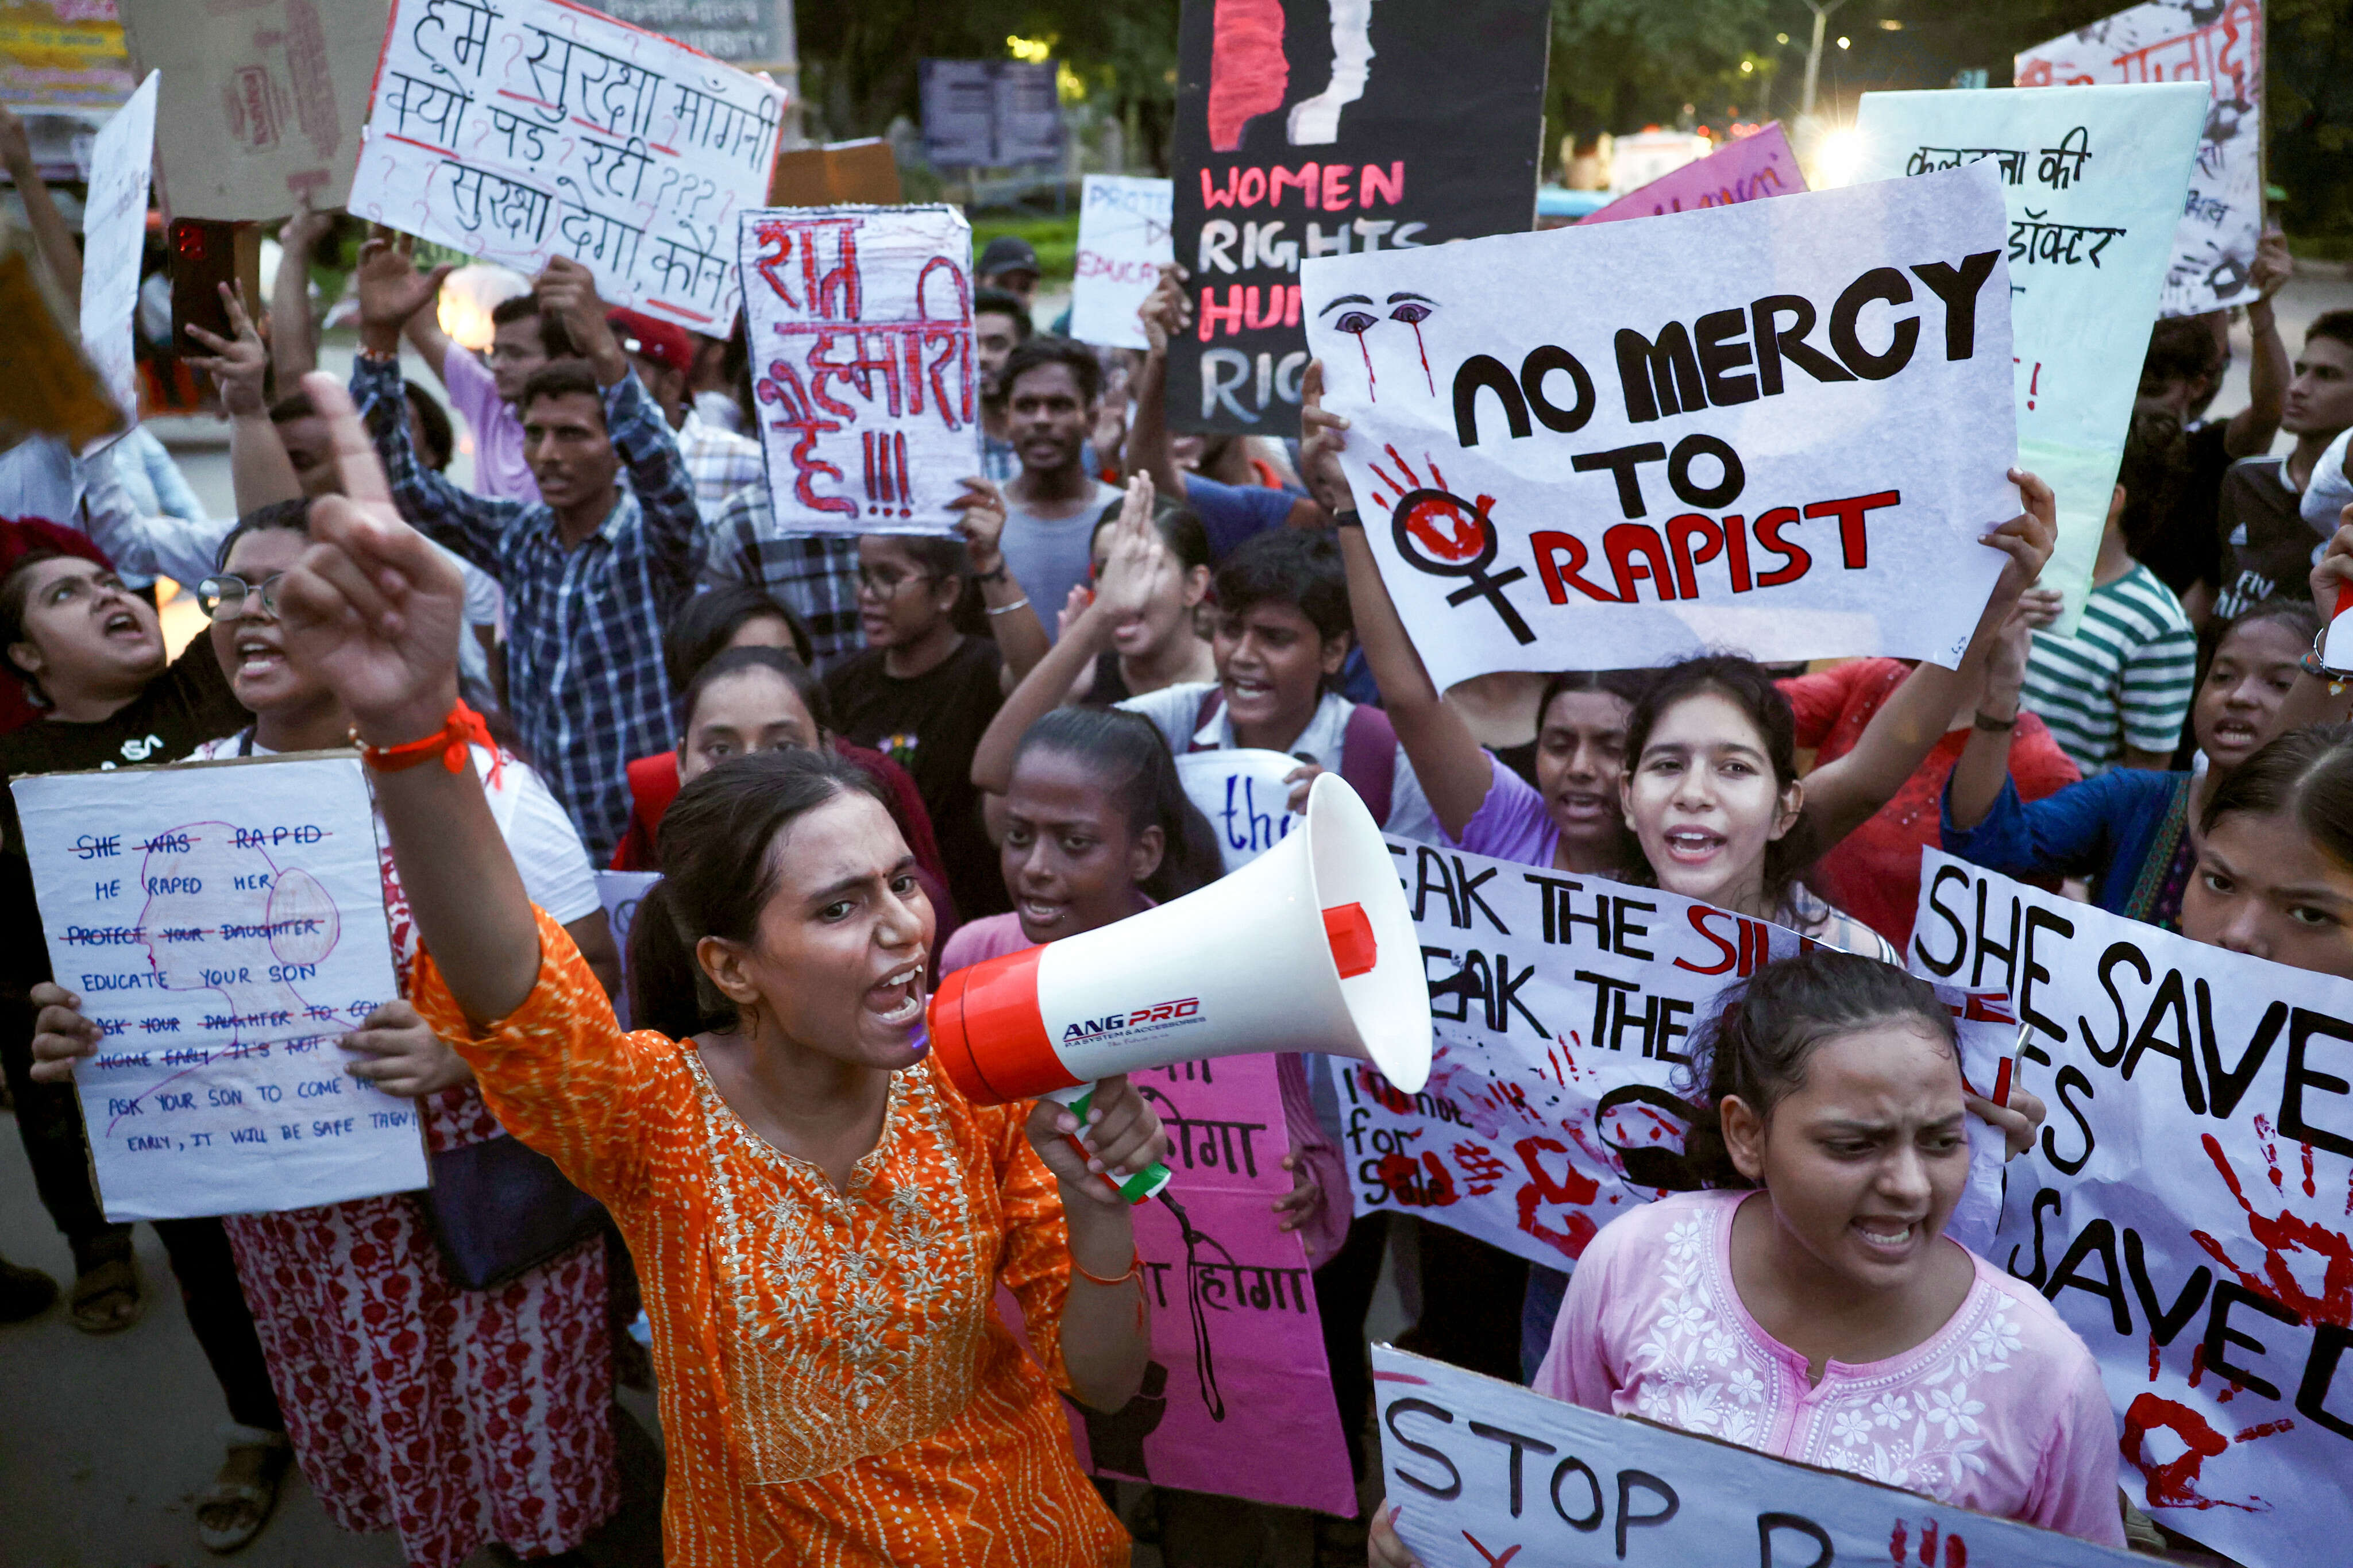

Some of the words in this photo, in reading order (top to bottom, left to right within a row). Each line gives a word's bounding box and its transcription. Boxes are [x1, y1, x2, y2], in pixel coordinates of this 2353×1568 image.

[2038, 126, 2092, 190] की
[1200, 161, 1405, 211] WOMEN
[754, 217, 864, 322] रात
[1197, 217, 1429, 275] RIGHTS
[1452, 345, 1596, 447] NO
[1614, 249, 2002, 424] MERCY
[1570, 434, 1746, 520] TO
[1528, 489, 1901, 605] RAPIST
[76, 835, 122, 860] SHE
[144, 835, 192, 855] WAS
[236, 825, 322, 849] RAPED
[95, 879, 120, 900] HE
[148, 876, 202, 896] RAPED
[234, 874, 275, 891] HER
[67, 925, 146, 946] PROTECT
[162, 928, 206, 943] YOUR
[221, 920, 320, 943] DAUGHTER
[1522, 873, 1657, 961] THE
[82, 971, 168, 991] EDUCATE
[199, 967, 252, 988] YOUR
[269, 964, 316, 983] SON
[1915, 864, 2076, 1043] SHE
[141, 1018, 180, 1033] YOUR
[204, 1011, 291, 1031] DAUGHTER
[306, 1006, 332, 1021] TO
[1063, 1014, 1124, 1040] ANG
[1128, 1001, 1199, 1026] PRO
[1574, 969, 1694, 1063] THE
[100, 1051, 152, 1069] HOME
[163, 1049, 209, 1065] EARLY
[288, 1037, 320, 1053] NOT
[109, 1097, 143, 1116] ASK
[153, 1094, 197, 1112] YOUR
[207, 1089, 243, 1106] SON
[259, 1085, 283, 1103] TO
[297, 1076, 343, 1098] COME
[191, 1133, 213, 1147] IT
[230, 1127, 268, 1144] WILL
[281, 1124, 302, 1140] BE
[313, 1118, 354, 1137] SAFE
[1345, 1106, 1416, 1158] for
[1384, 1397, 1680, 1562] STOP
